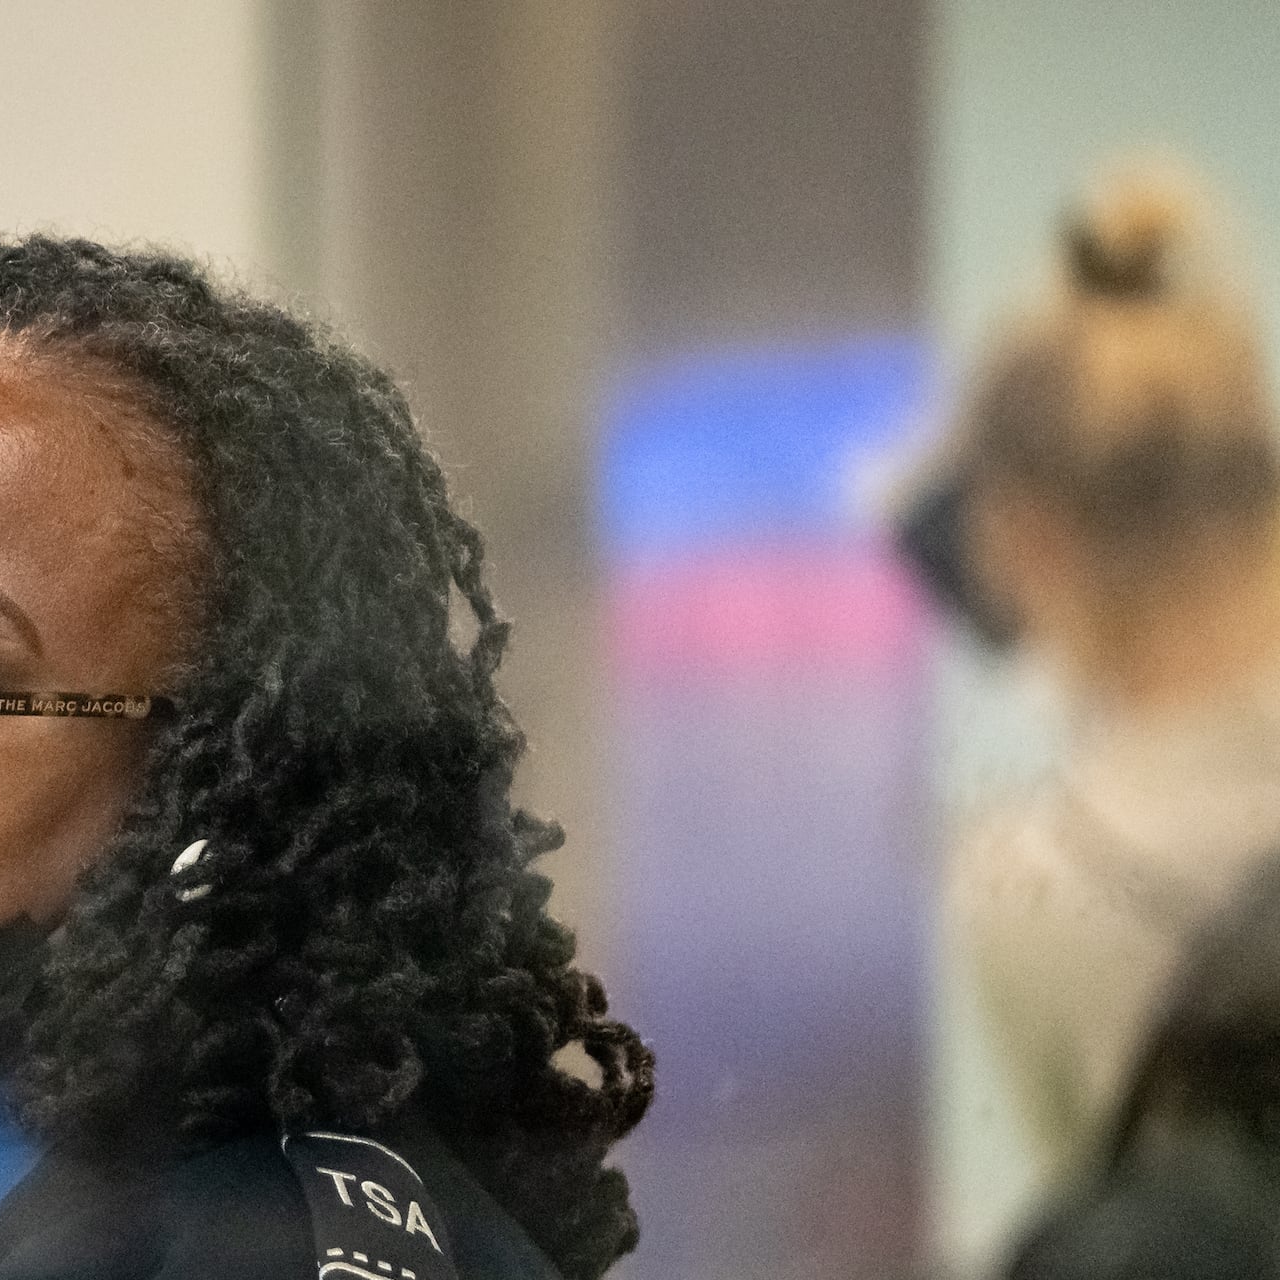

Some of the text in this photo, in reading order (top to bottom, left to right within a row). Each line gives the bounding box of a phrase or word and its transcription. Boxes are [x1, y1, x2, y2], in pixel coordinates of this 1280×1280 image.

[31, 698, 76, 713] MARC
[81, 699, 148, 714] JACOBS
[315, 1166, 445, 1256] TSA
